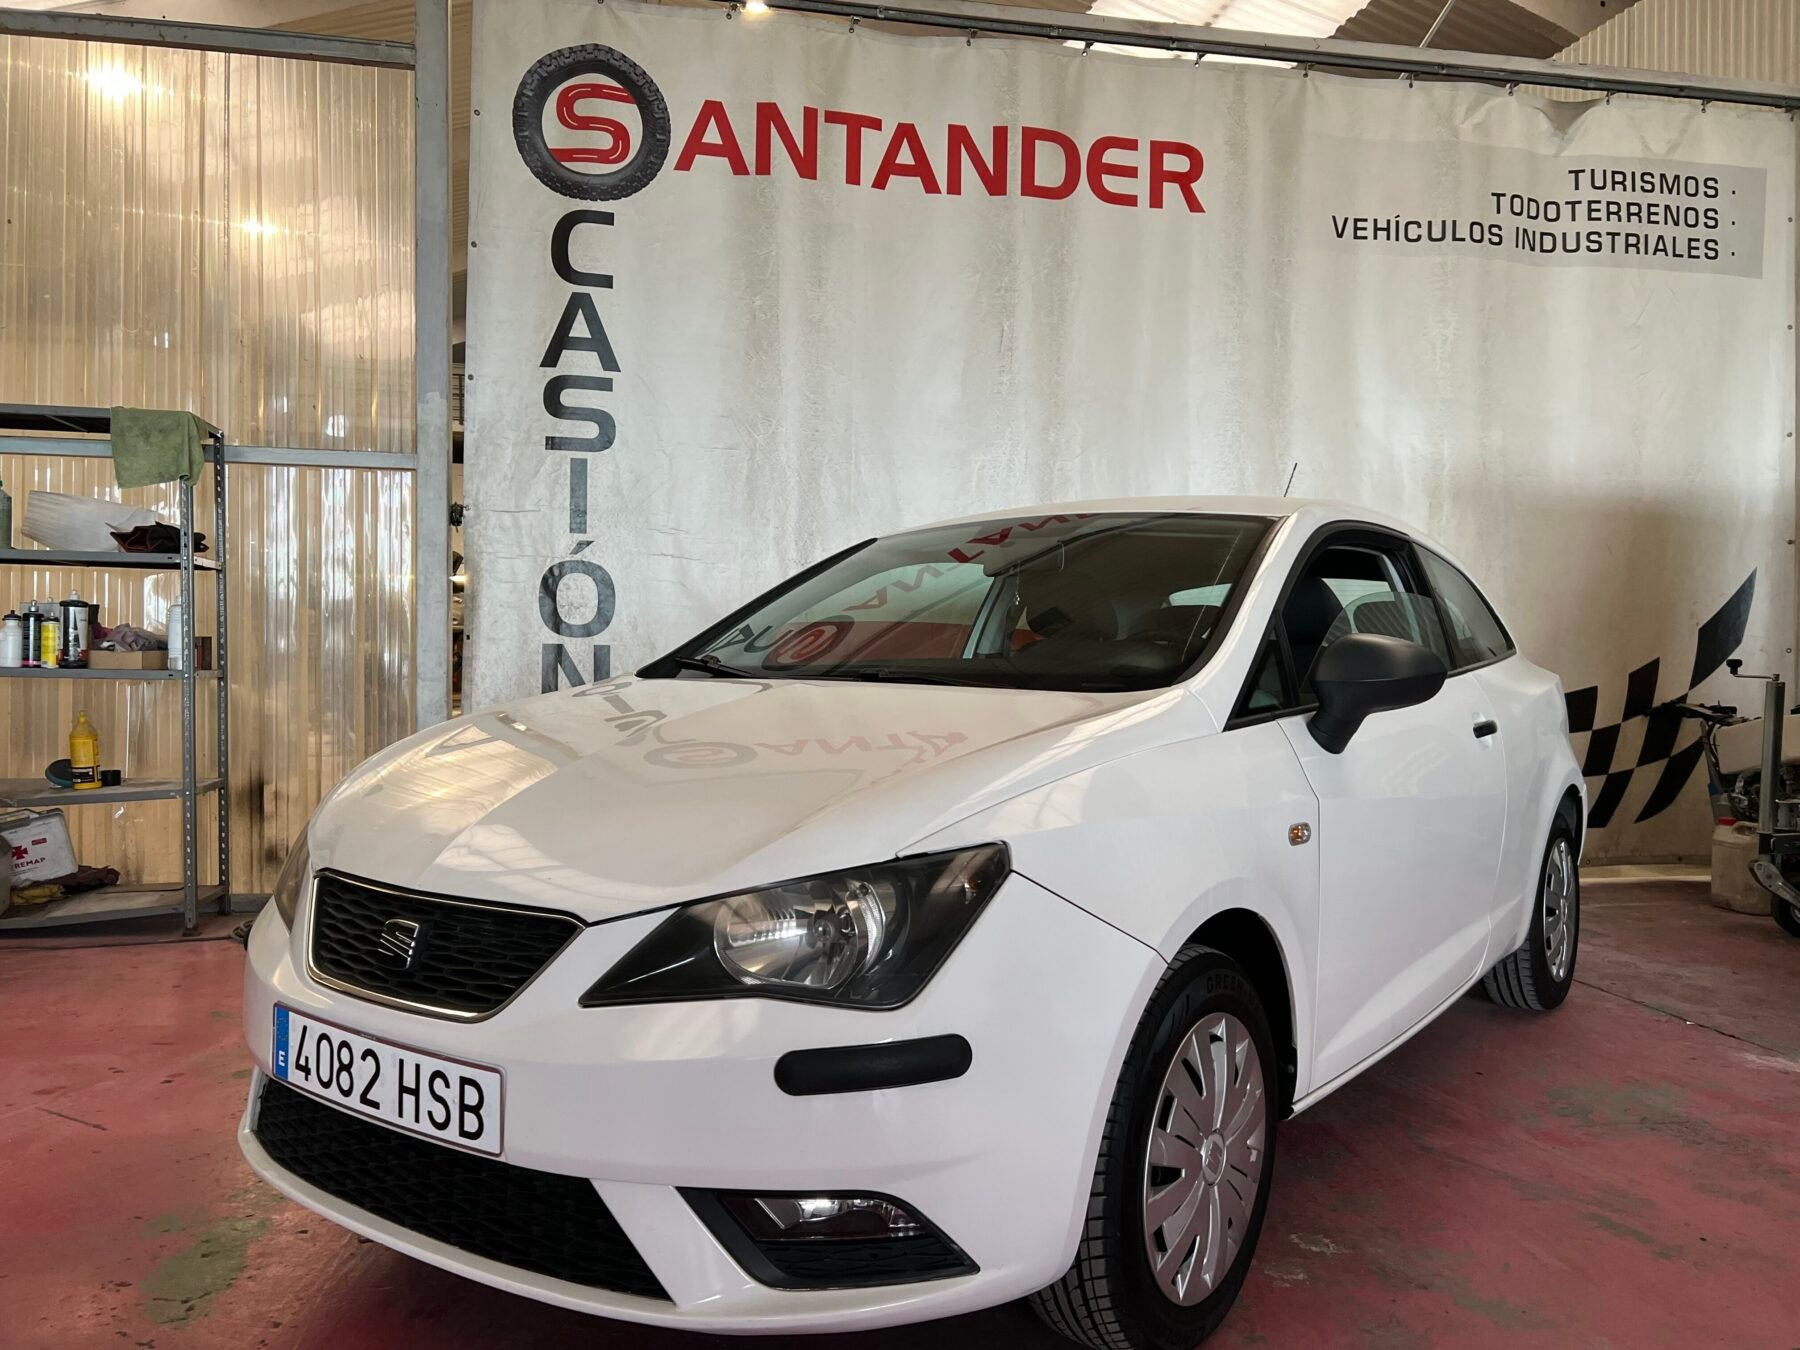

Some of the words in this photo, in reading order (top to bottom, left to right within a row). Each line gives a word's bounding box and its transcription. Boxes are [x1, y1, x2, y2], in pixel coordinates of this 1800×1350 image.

[1568, 168, 1719, 199] TURISMOS
[1491, 192, 1719, 230] TODOTERRENOS
[1332, 214, 1503, 246] VEHÍCULOS
[1515, 226, 1719, 261] INDUSTRIALES
[278, 1050, 286, 1067] E
[294, 1024, 381, 1111] 4082
[398, 1058, 485, 1141] HSB
